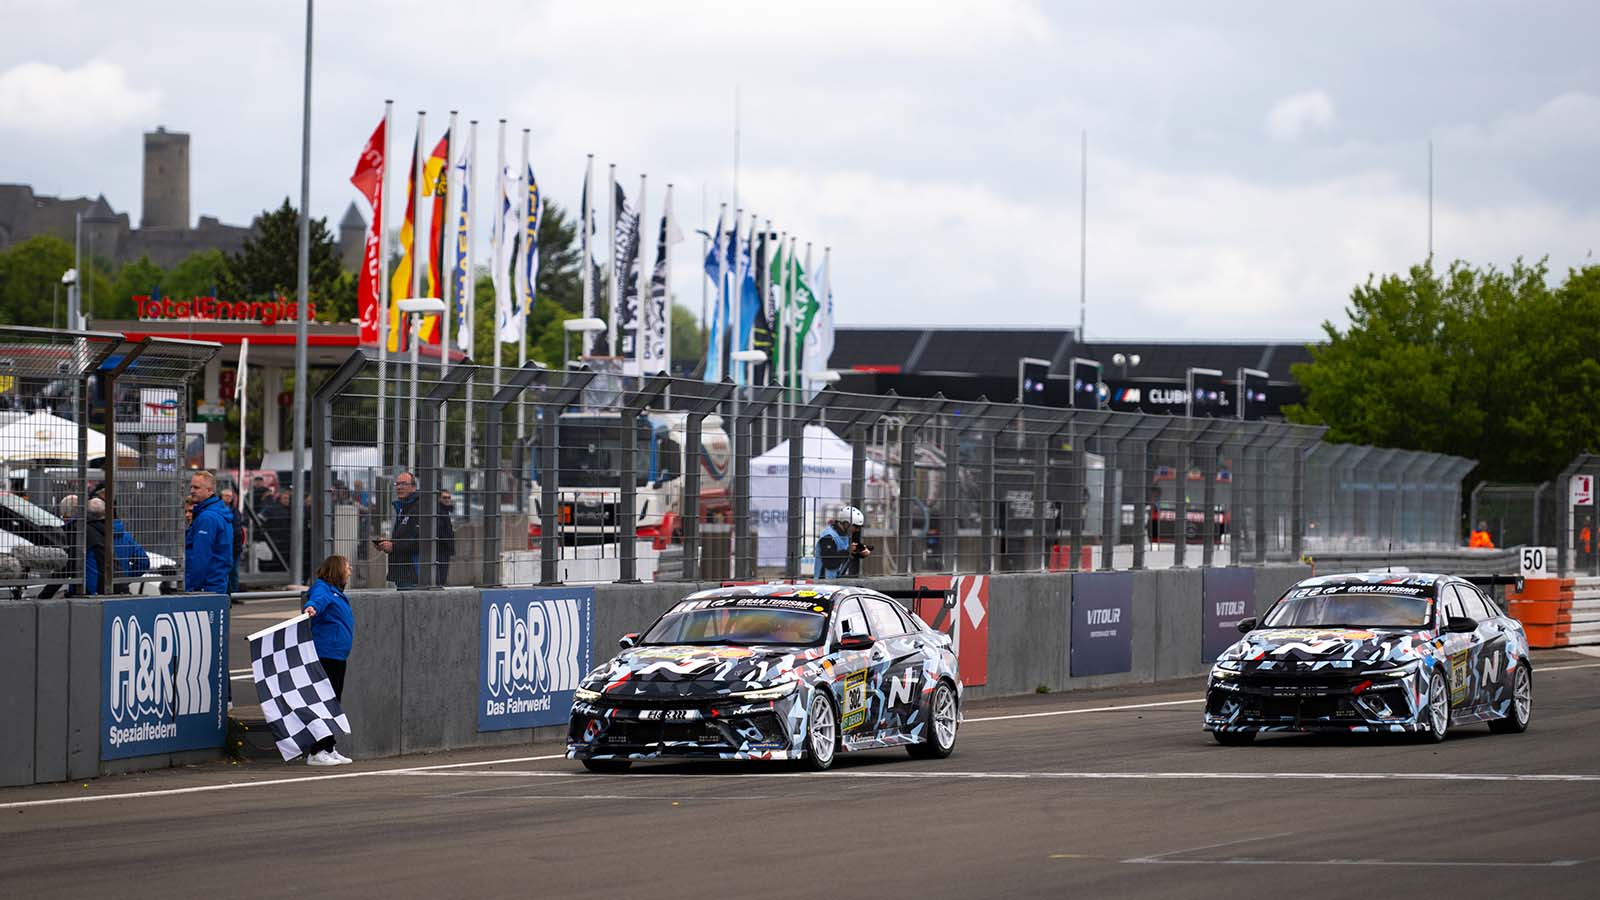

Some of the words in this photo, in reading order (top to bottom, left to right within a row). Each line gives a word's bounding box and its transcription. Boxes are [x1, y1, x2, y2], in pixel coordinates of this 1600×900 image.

[132, 295, 316, 326] TotalEnergies
[1524, 549, 1543, 570] 50
[946, 594, 954, 605] N
[1348, 585, 1376, 593] GRAN
[1377, 586, 1420, 595] TURISMO
[767, 599, 812, 609] TURISMO
[1215, 601, 1246, 616] VITOUR
[1087, 607, 1121, 625] VITOUR
[488, 602, 550, 697] H&R
[111, 615, 178, 722] H&R
[1482, 650, 1500, 687] N
[888, 667, 913, 708] N
[487, 699, 505, 716] Das
[506, 695, 551, 715] Fahrwerk!
[849, 687, 861, 711] 302
[109, 721, 177, 748] Spezialfedern
